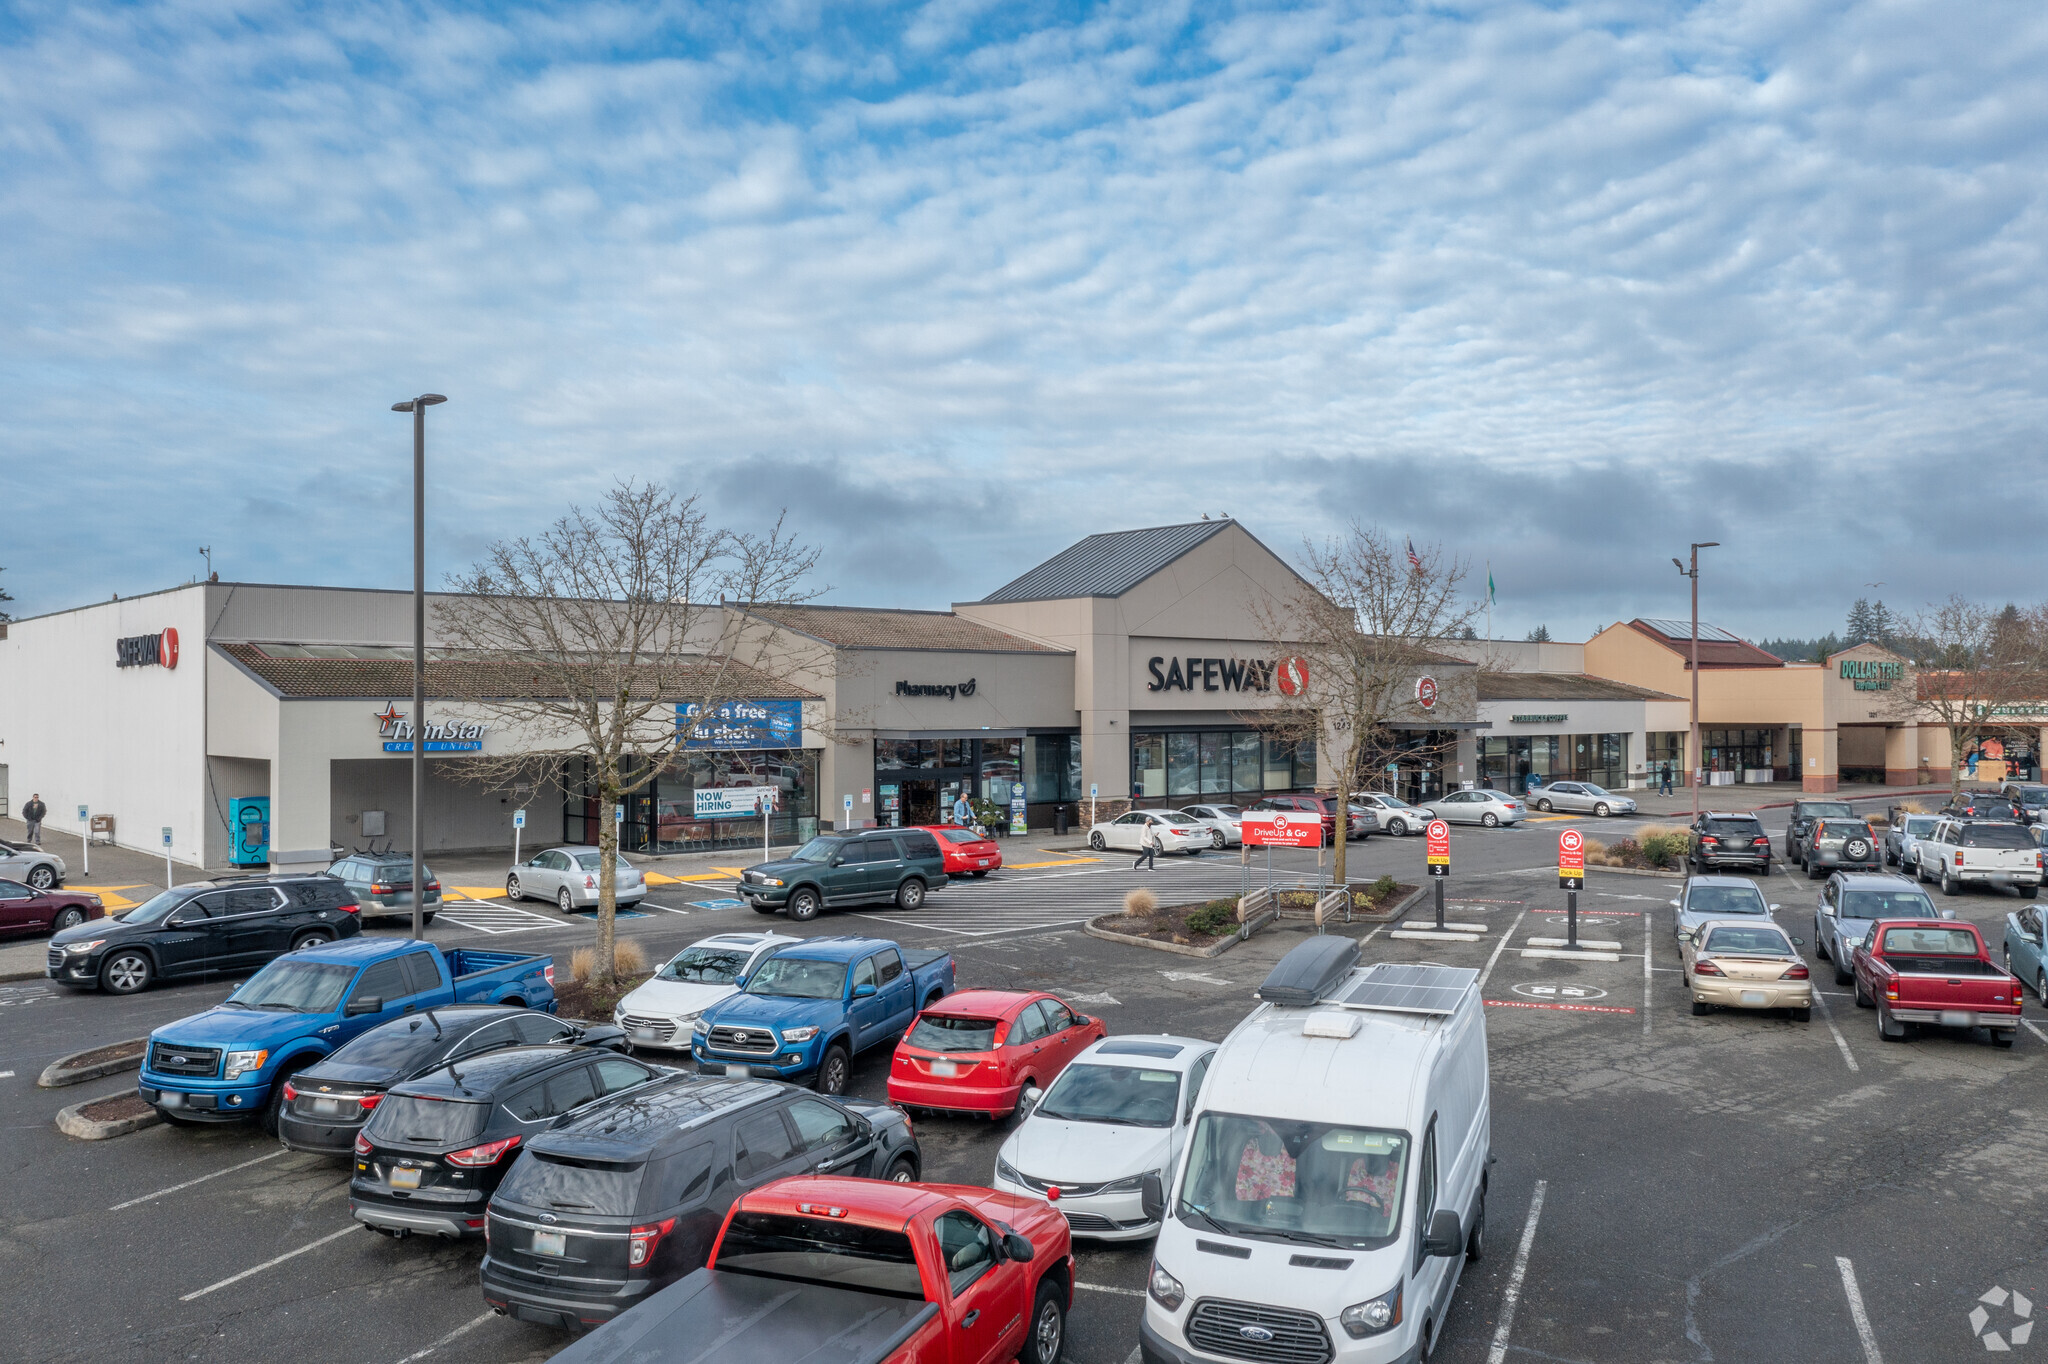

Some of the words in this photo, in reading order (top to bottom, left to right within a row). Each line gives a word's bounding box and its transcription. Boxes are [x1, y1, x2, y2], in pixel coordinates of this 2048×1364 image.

[116, 634, 162, 668] SAFEWAY
[1148, 656, 1277, 692] SAFEWAY
[1841, 660, 1878, 680] DOLLAR
[895, 680, 957, 700] Pharmacy
[721, 707, 730, 719] a
[734, 704, 767, 719] free
[392, 719, 490, 740] TwinStar
[386, 742, 433, 751] CRET
[440, 741, 480, 751] UNION
[696, 791, 723, 801] NOW
[696, 801, 732, 811] HIRING
[1254, 828, 1285, 837] DriveUp
[1286, 829, 1293, 837] &
[1294, 829, 1308, 837] Go
[1435, 865, 1442, 875] 3
[1567, 878, 1576, 888] 4
[1488, 1000, 1551, 1008] Online
[1559, 1004, 1631, 1013] Orders
